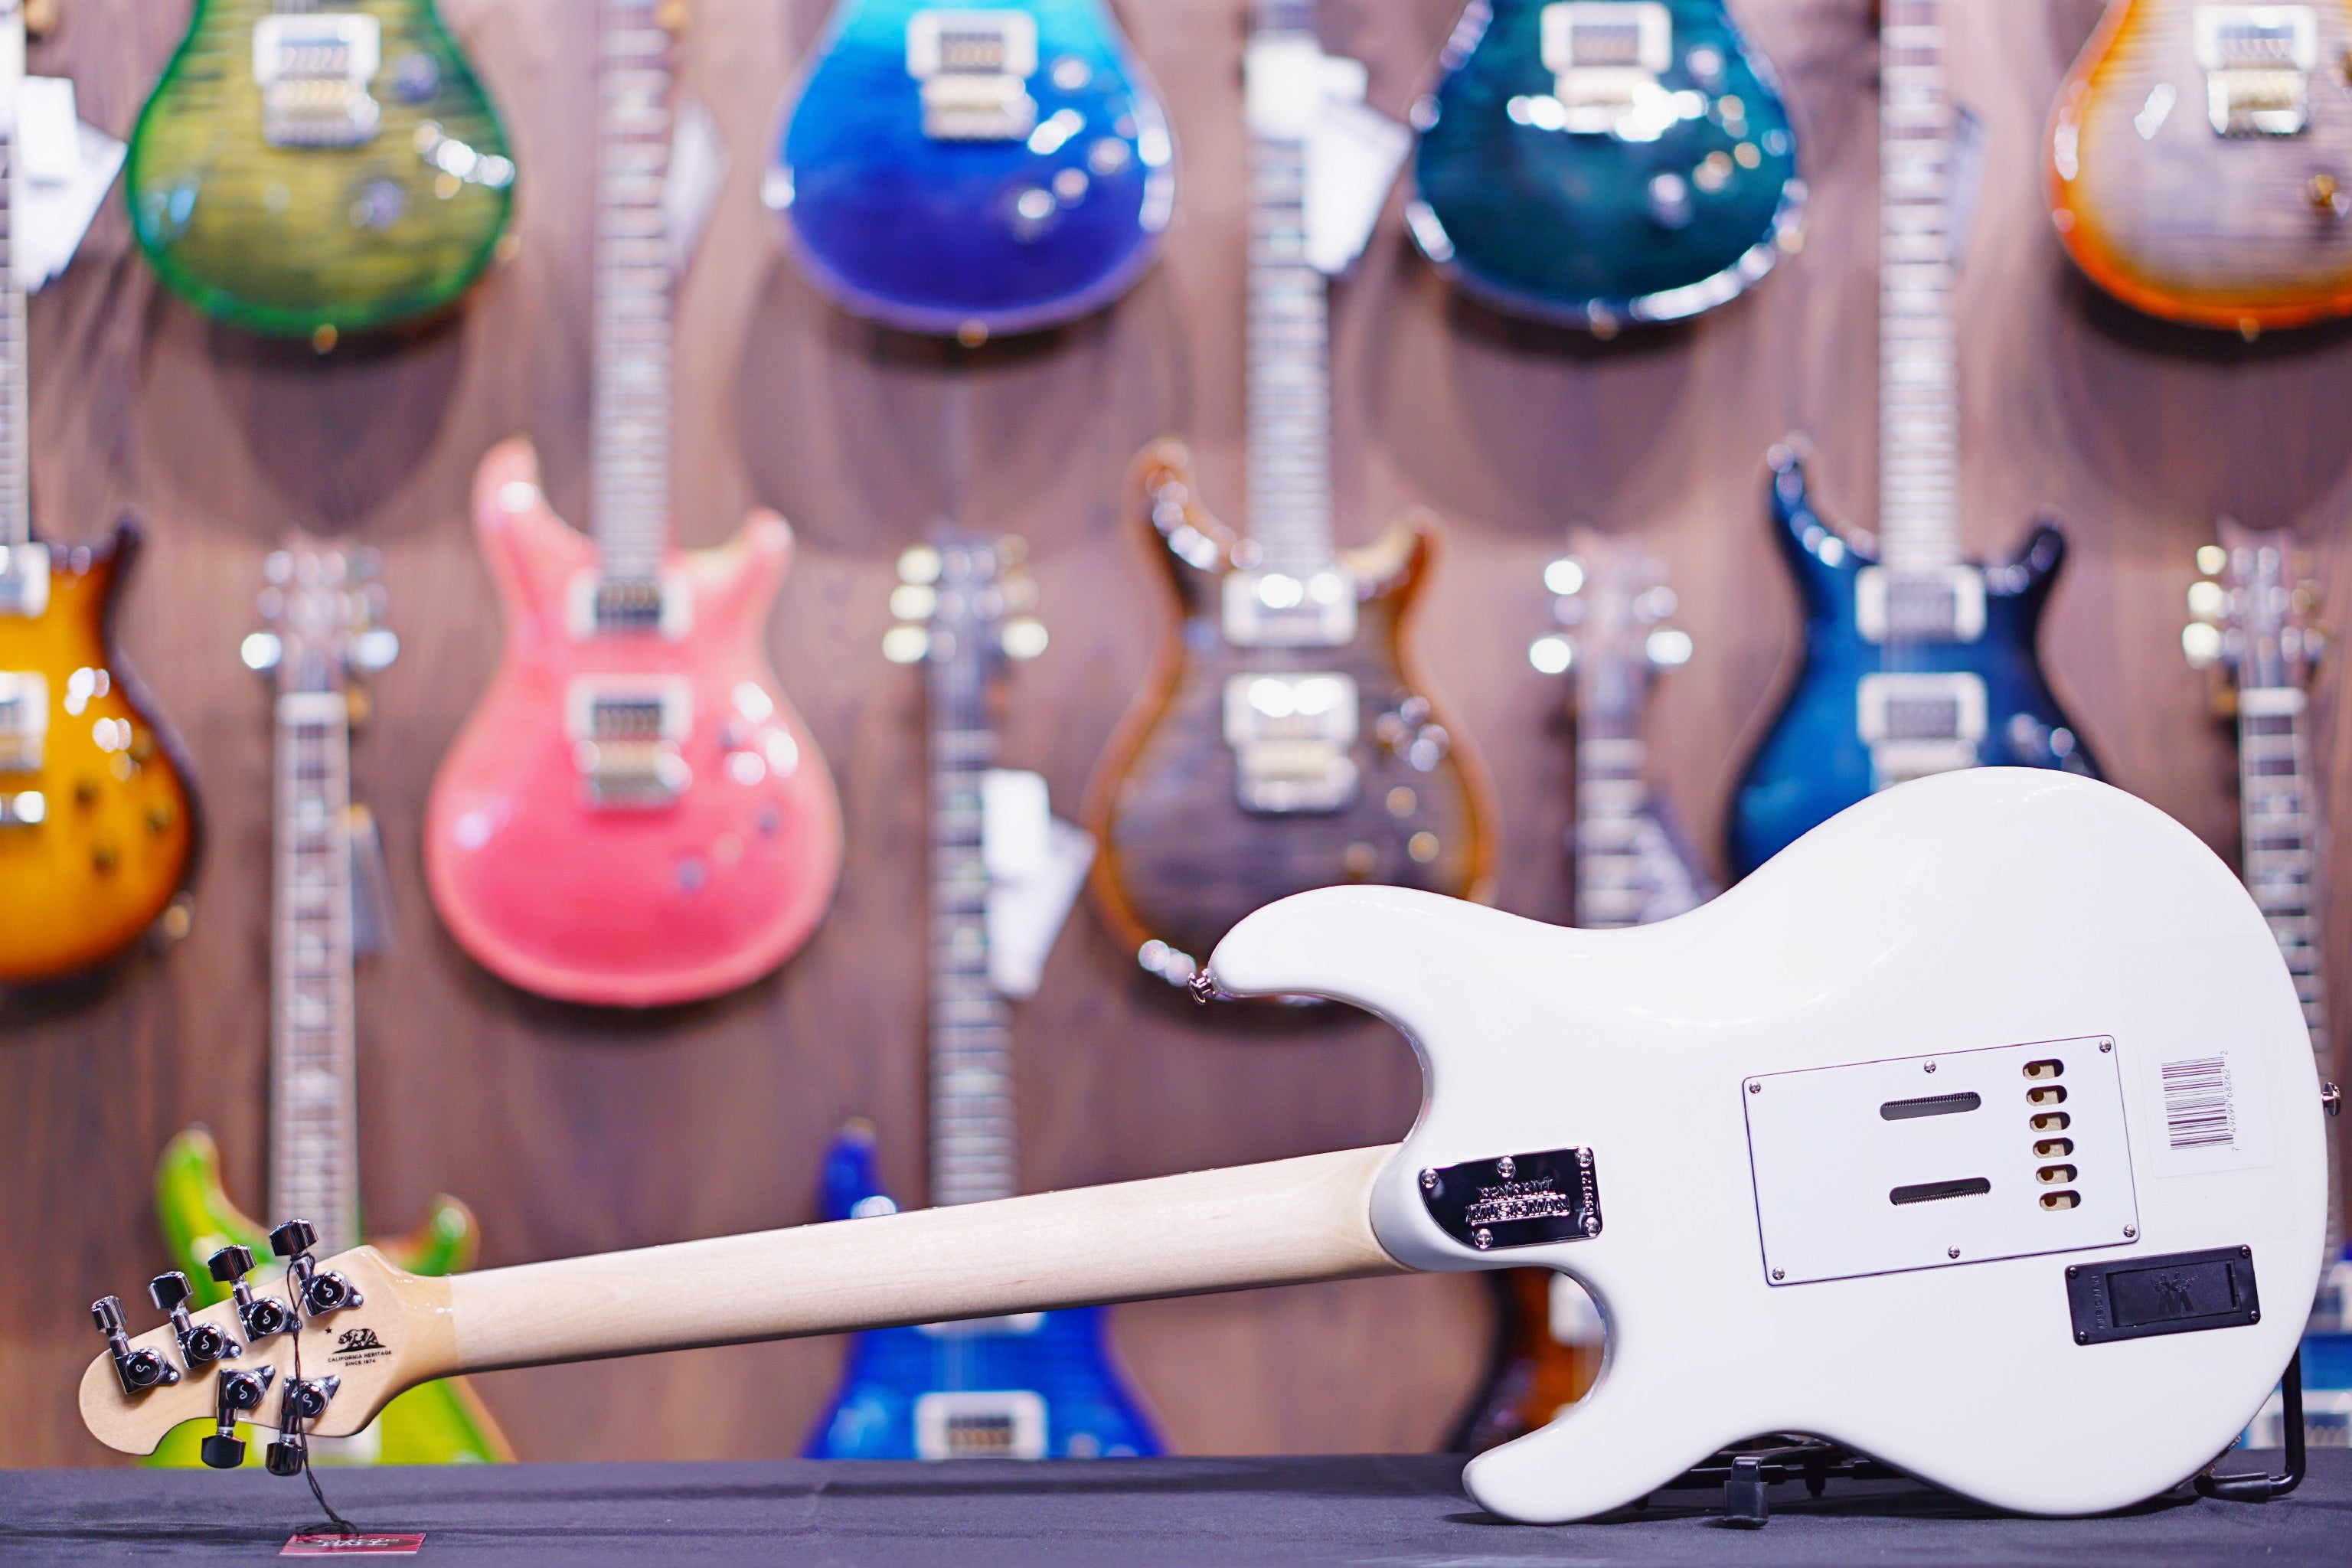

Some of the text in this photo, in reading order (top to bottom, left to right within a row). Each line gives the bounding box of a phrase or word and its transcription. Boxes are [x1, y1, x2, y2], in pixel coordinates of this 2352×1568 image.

[2223, 1068, 2233, 1098] 68262
[2226, 1103, 2236, 1133] 49699
[328, 1350, 392, 1363] CALIFORNIA HERITAGE
